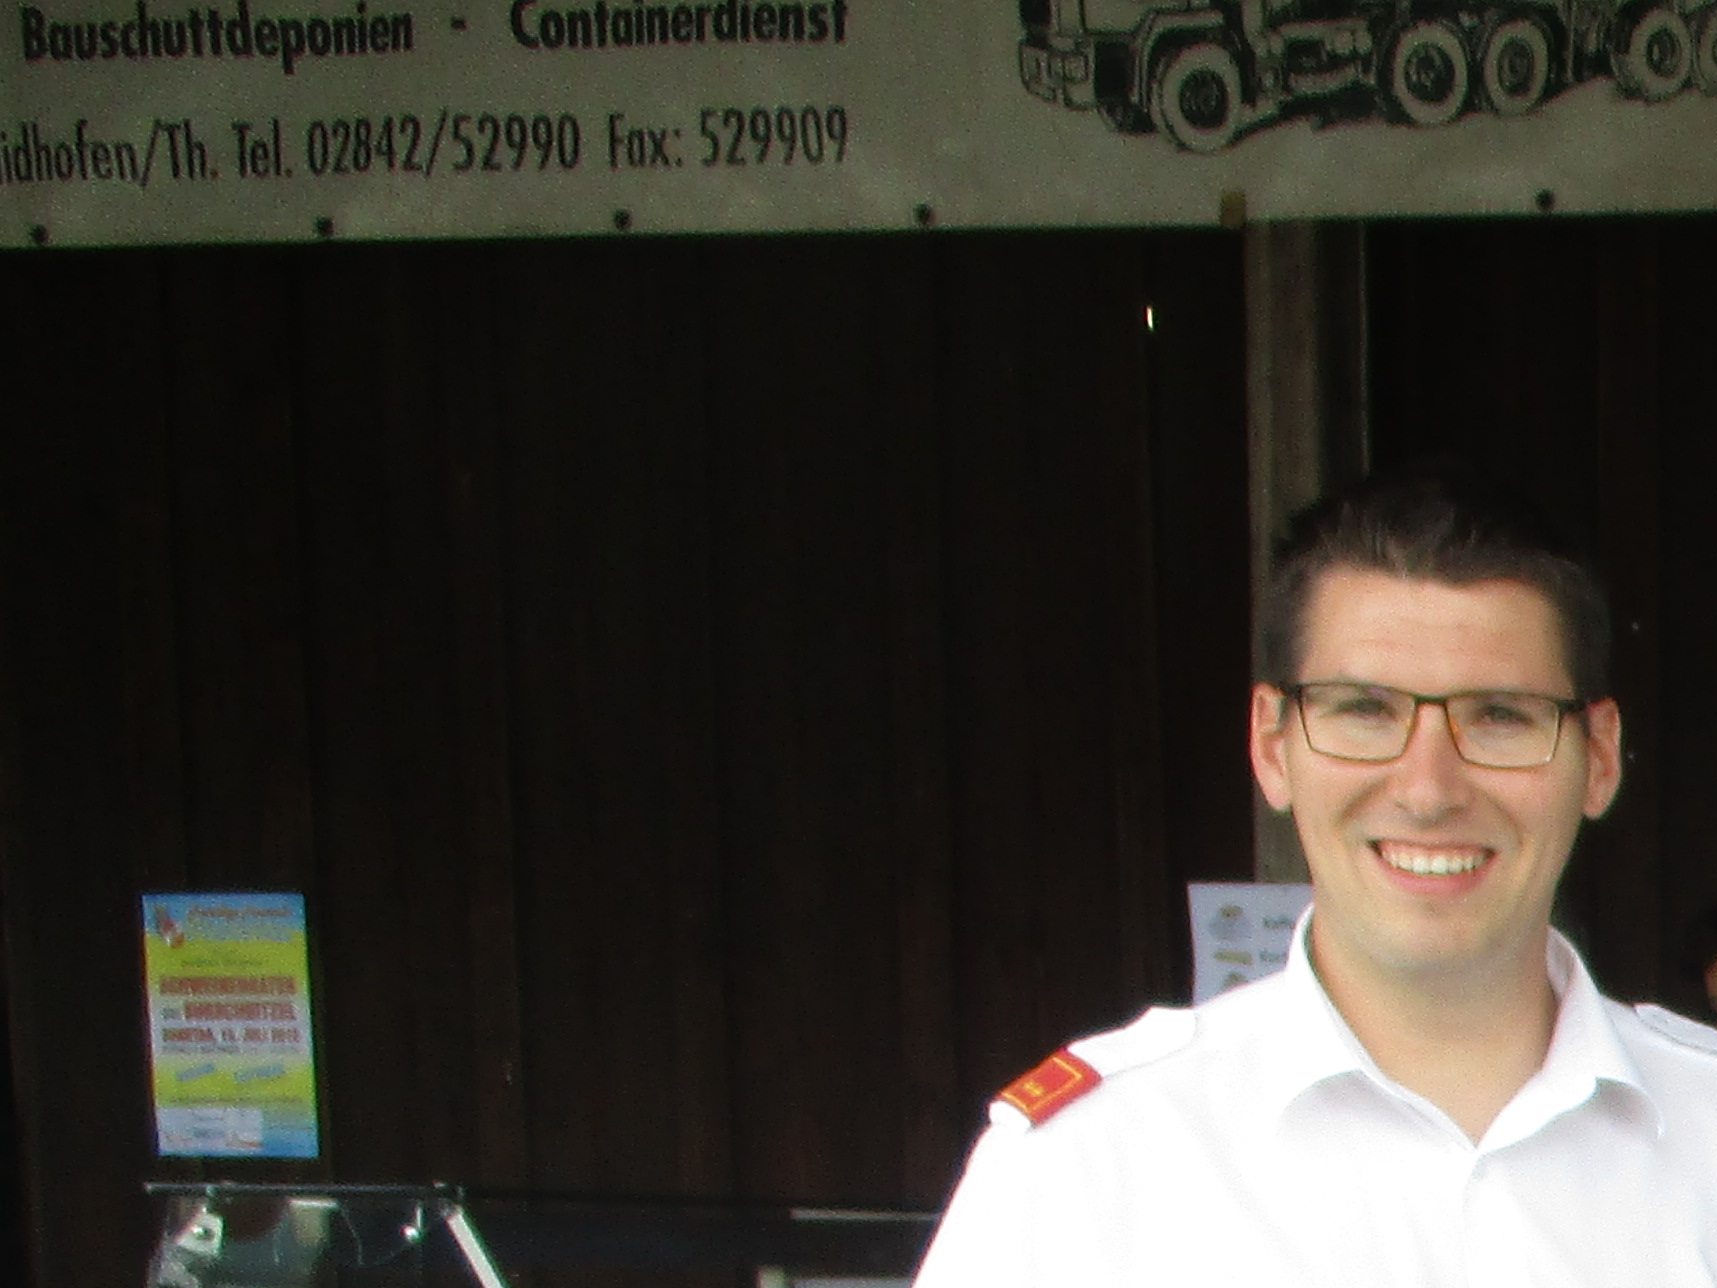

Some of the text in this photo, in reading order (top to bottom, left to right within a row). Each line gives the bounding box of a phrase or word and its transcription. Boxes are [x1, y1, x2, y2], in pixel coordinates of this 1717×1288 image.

[21, 0, 416, 75] Bauschuttdeponien
[508, 0, 849, 49] Containerdienst
[231, 116, 294, 178] Tel.
[307, 105, 581, 179] 02842/52990
[608, 112, 685, 169] Fax:
[699, 104, 849, 168] 529909
